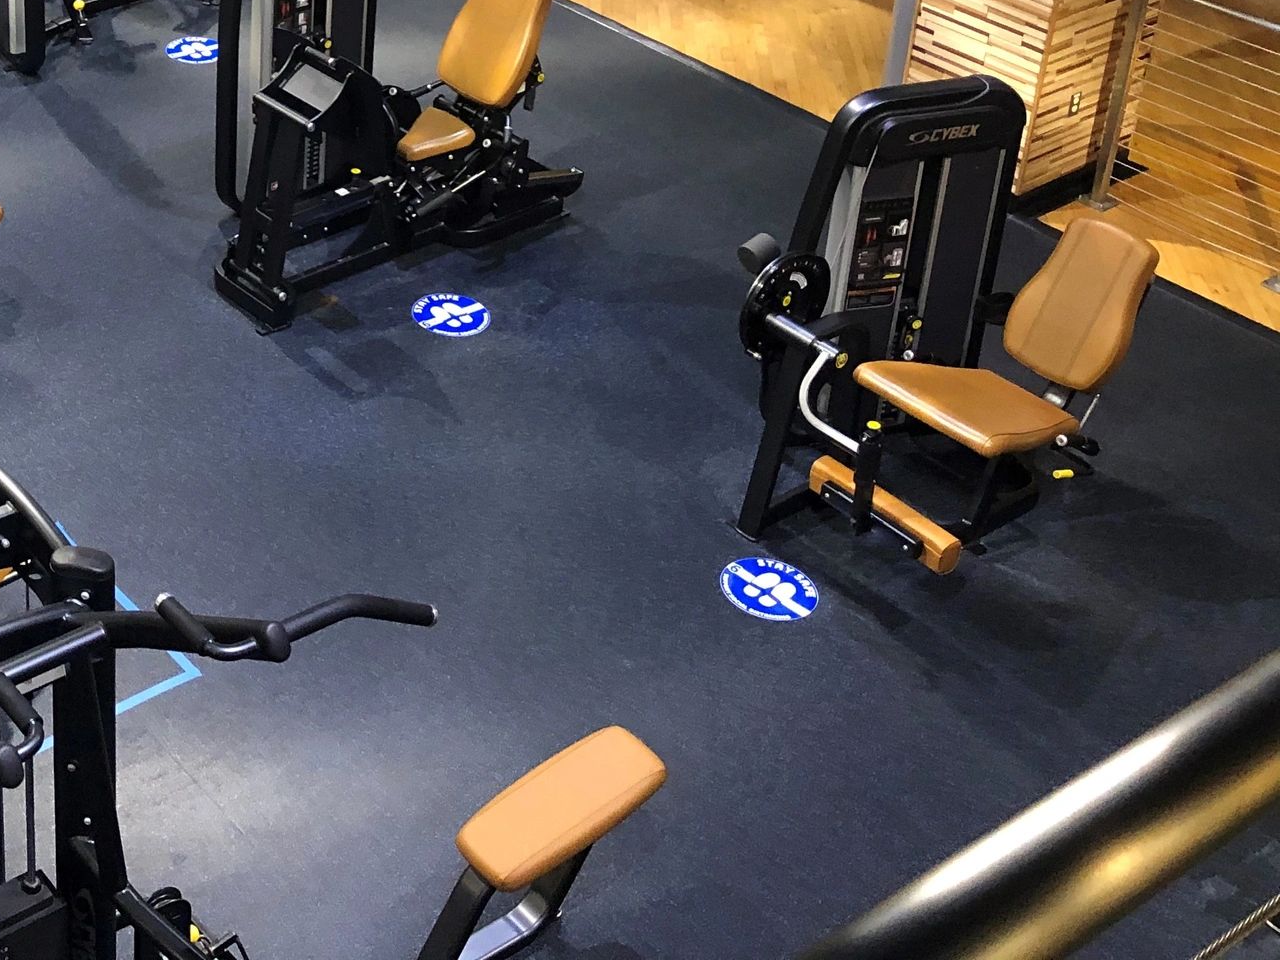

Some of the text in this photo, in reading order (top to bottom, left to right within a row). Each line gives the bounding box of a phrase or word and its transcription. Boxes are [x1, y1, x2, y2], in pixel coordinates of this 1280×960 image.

[930, 124, 980, 142] CYBEX
[414, 297, 430, 313] STAY
[757, 558, 817, 598] STAY SAFE
